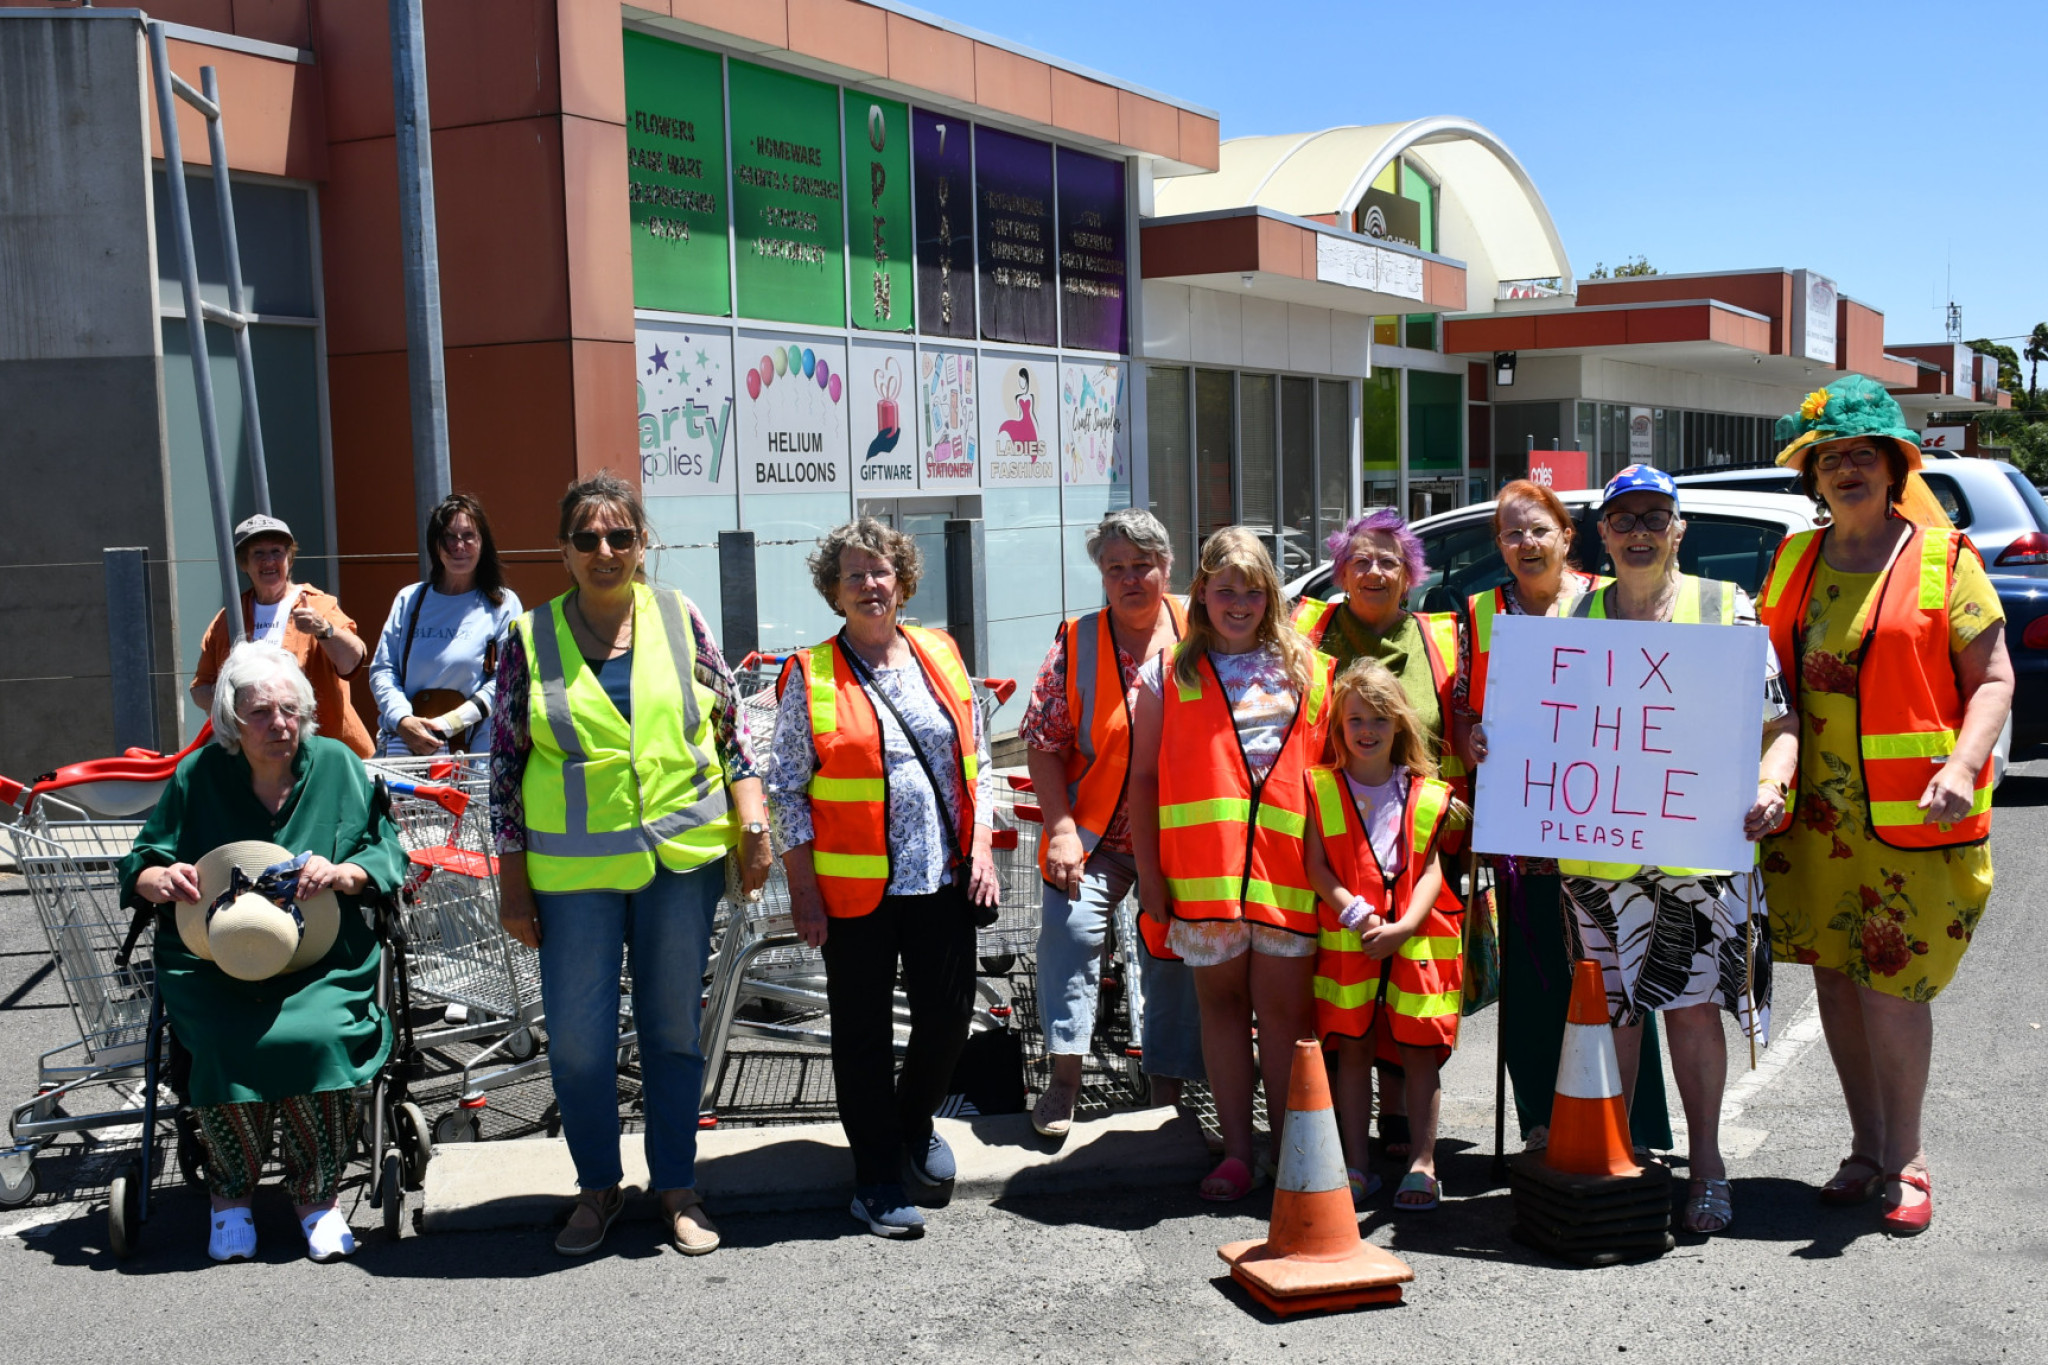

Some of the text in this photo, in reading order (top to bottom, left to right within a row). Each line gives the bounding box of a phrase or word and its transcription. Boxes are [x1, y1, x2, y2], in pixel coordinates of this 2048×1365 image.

[635, 110, 695, 142] FLOWERS
[757, 136, 822, 167] HOMEWARE
[667, 153, 703, 179] WARE
[868, 103, 891, 320] OPEN
[1073, 406, 1092, 434] Craft
[768, 432, 823, 453] HELIUM
[996, 440, 1047, 457] LADIES
[640, 446, 703, 485] pplies
[756, 462, 836, 483] BALLOONS
[860, 464, 912, 481] GIFTWARE
[926, 463, 974, 479] STATIONERY
[990, 462, 1053, 479] FASHION
[1530, 461, 1552, 487] coles
[1551, 645, 1673, 694] FIX
[1541, 699, 1676, 754] THE
[1524, 758, 1699, 822] HOLE
[1541, 820, 1645, 850] PLEASE
